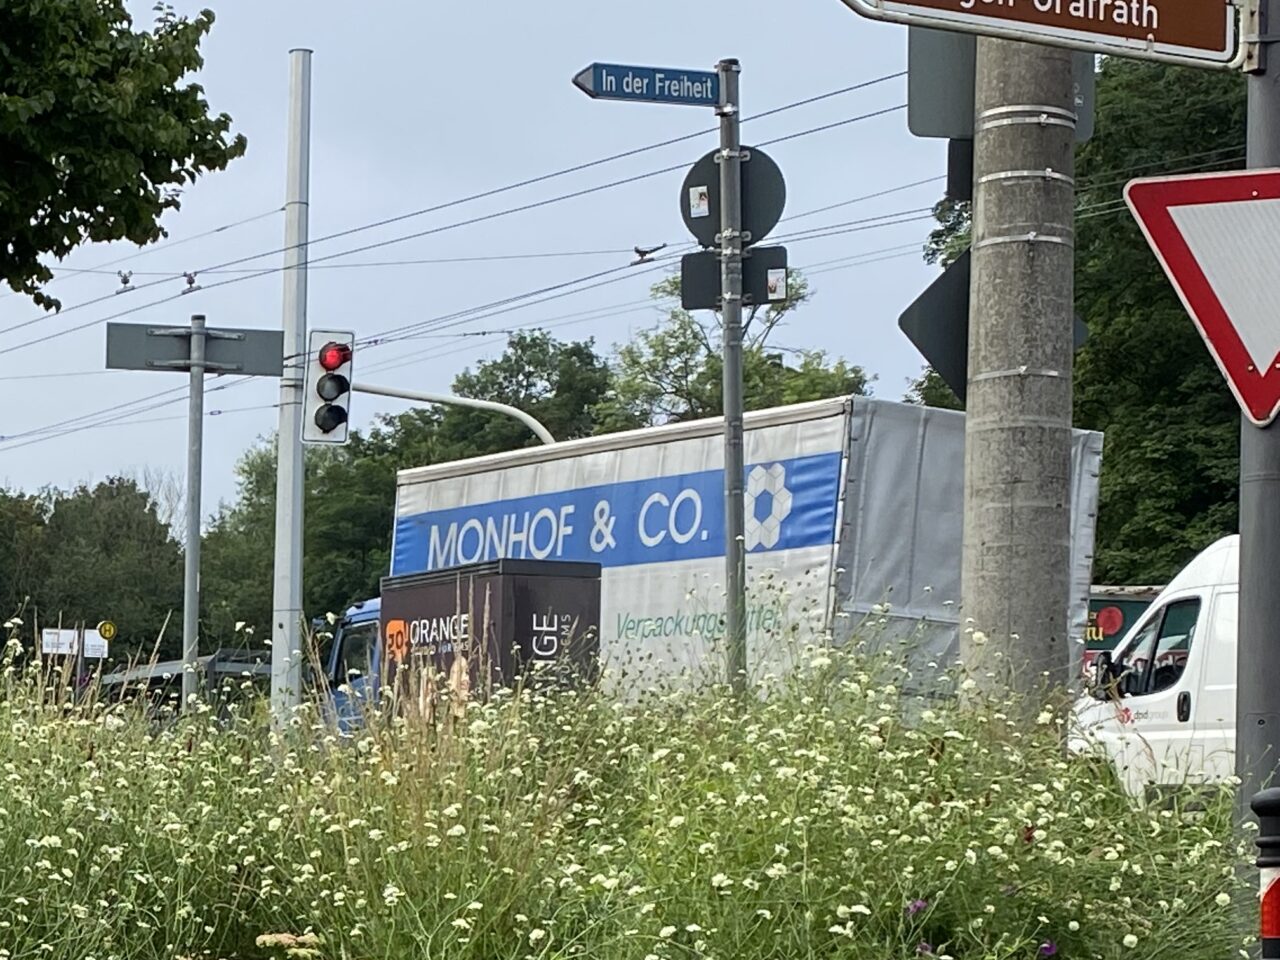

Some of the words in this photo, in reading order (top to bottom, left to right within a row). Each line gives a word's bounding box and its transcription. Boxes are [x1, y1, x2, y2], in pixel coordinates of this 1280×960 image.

[602, 69, 616, 92] In
[623, 72, 649, 94] der
[655, 73, 713, 99] Freiheit
[427, 505, 574, 570] MONHOF
[590, 500, 616, 552] &
[638, 488, 708, 547] CO.
[410, 613, 469, 645] ORANGE
